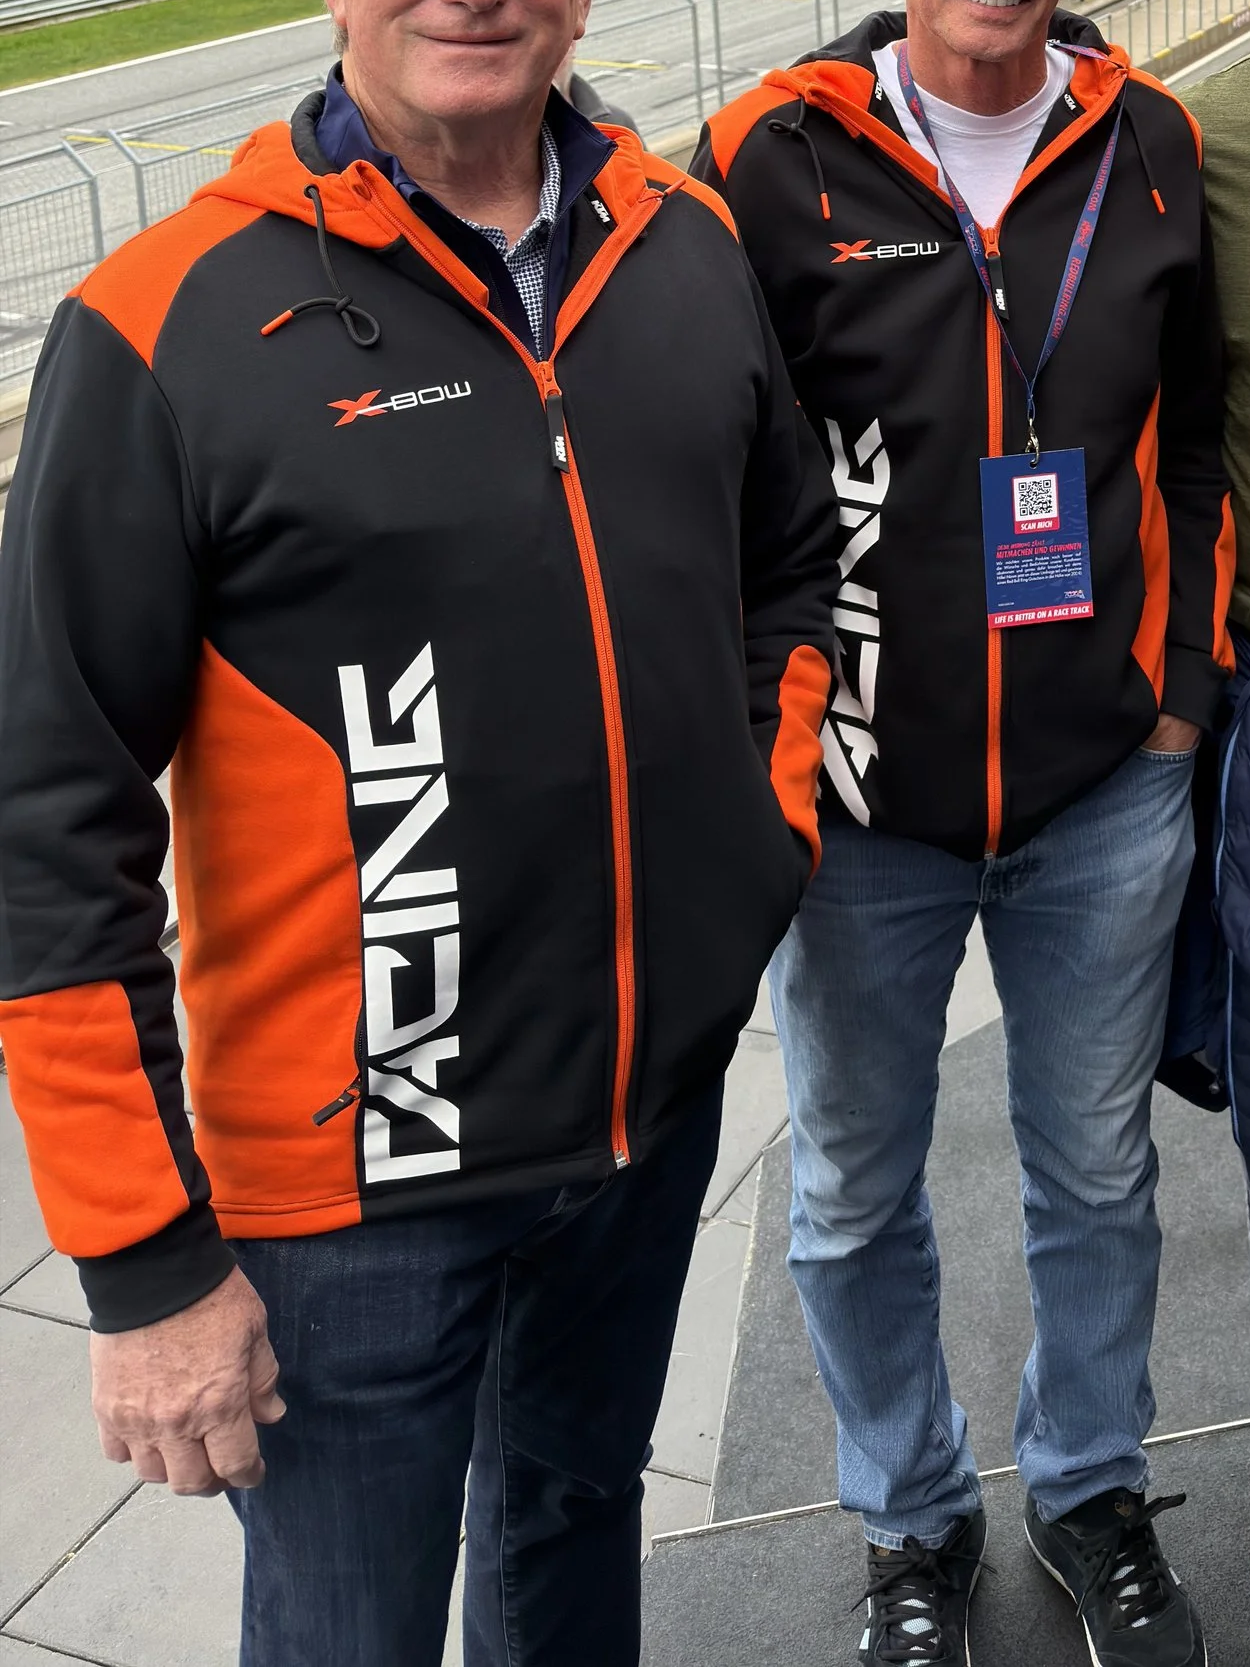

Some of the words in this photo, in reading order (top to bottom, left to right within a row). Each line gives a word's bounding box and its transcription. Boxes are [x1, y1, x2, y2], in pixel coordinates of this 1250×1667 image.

[591, 200, 611, 223] KTM
[831, 239, 940, 264] X-BOW
[1051, 257, 1082, 340] REDBULLRING.COM
[327, 381, 471, 427] X-BOW
[1020, 523, 1036, 531] SCAN
[1037, 521, 1053, 529] MICH
[1034, 546, 1048, 555] UND
[817, 417, 892, 828] ACING
[994, 616, 1007, 625] LIFE
[1007, 615, 1014, 623] IS
[1014, 612, 1036, 622] BETTER
[1036, 610, 1047, 619] ON
[1047, 609, 1053, 618] A
[1053, 607, 1069, 617] RACE
[1070, 605, 1090, 615] TRACK
